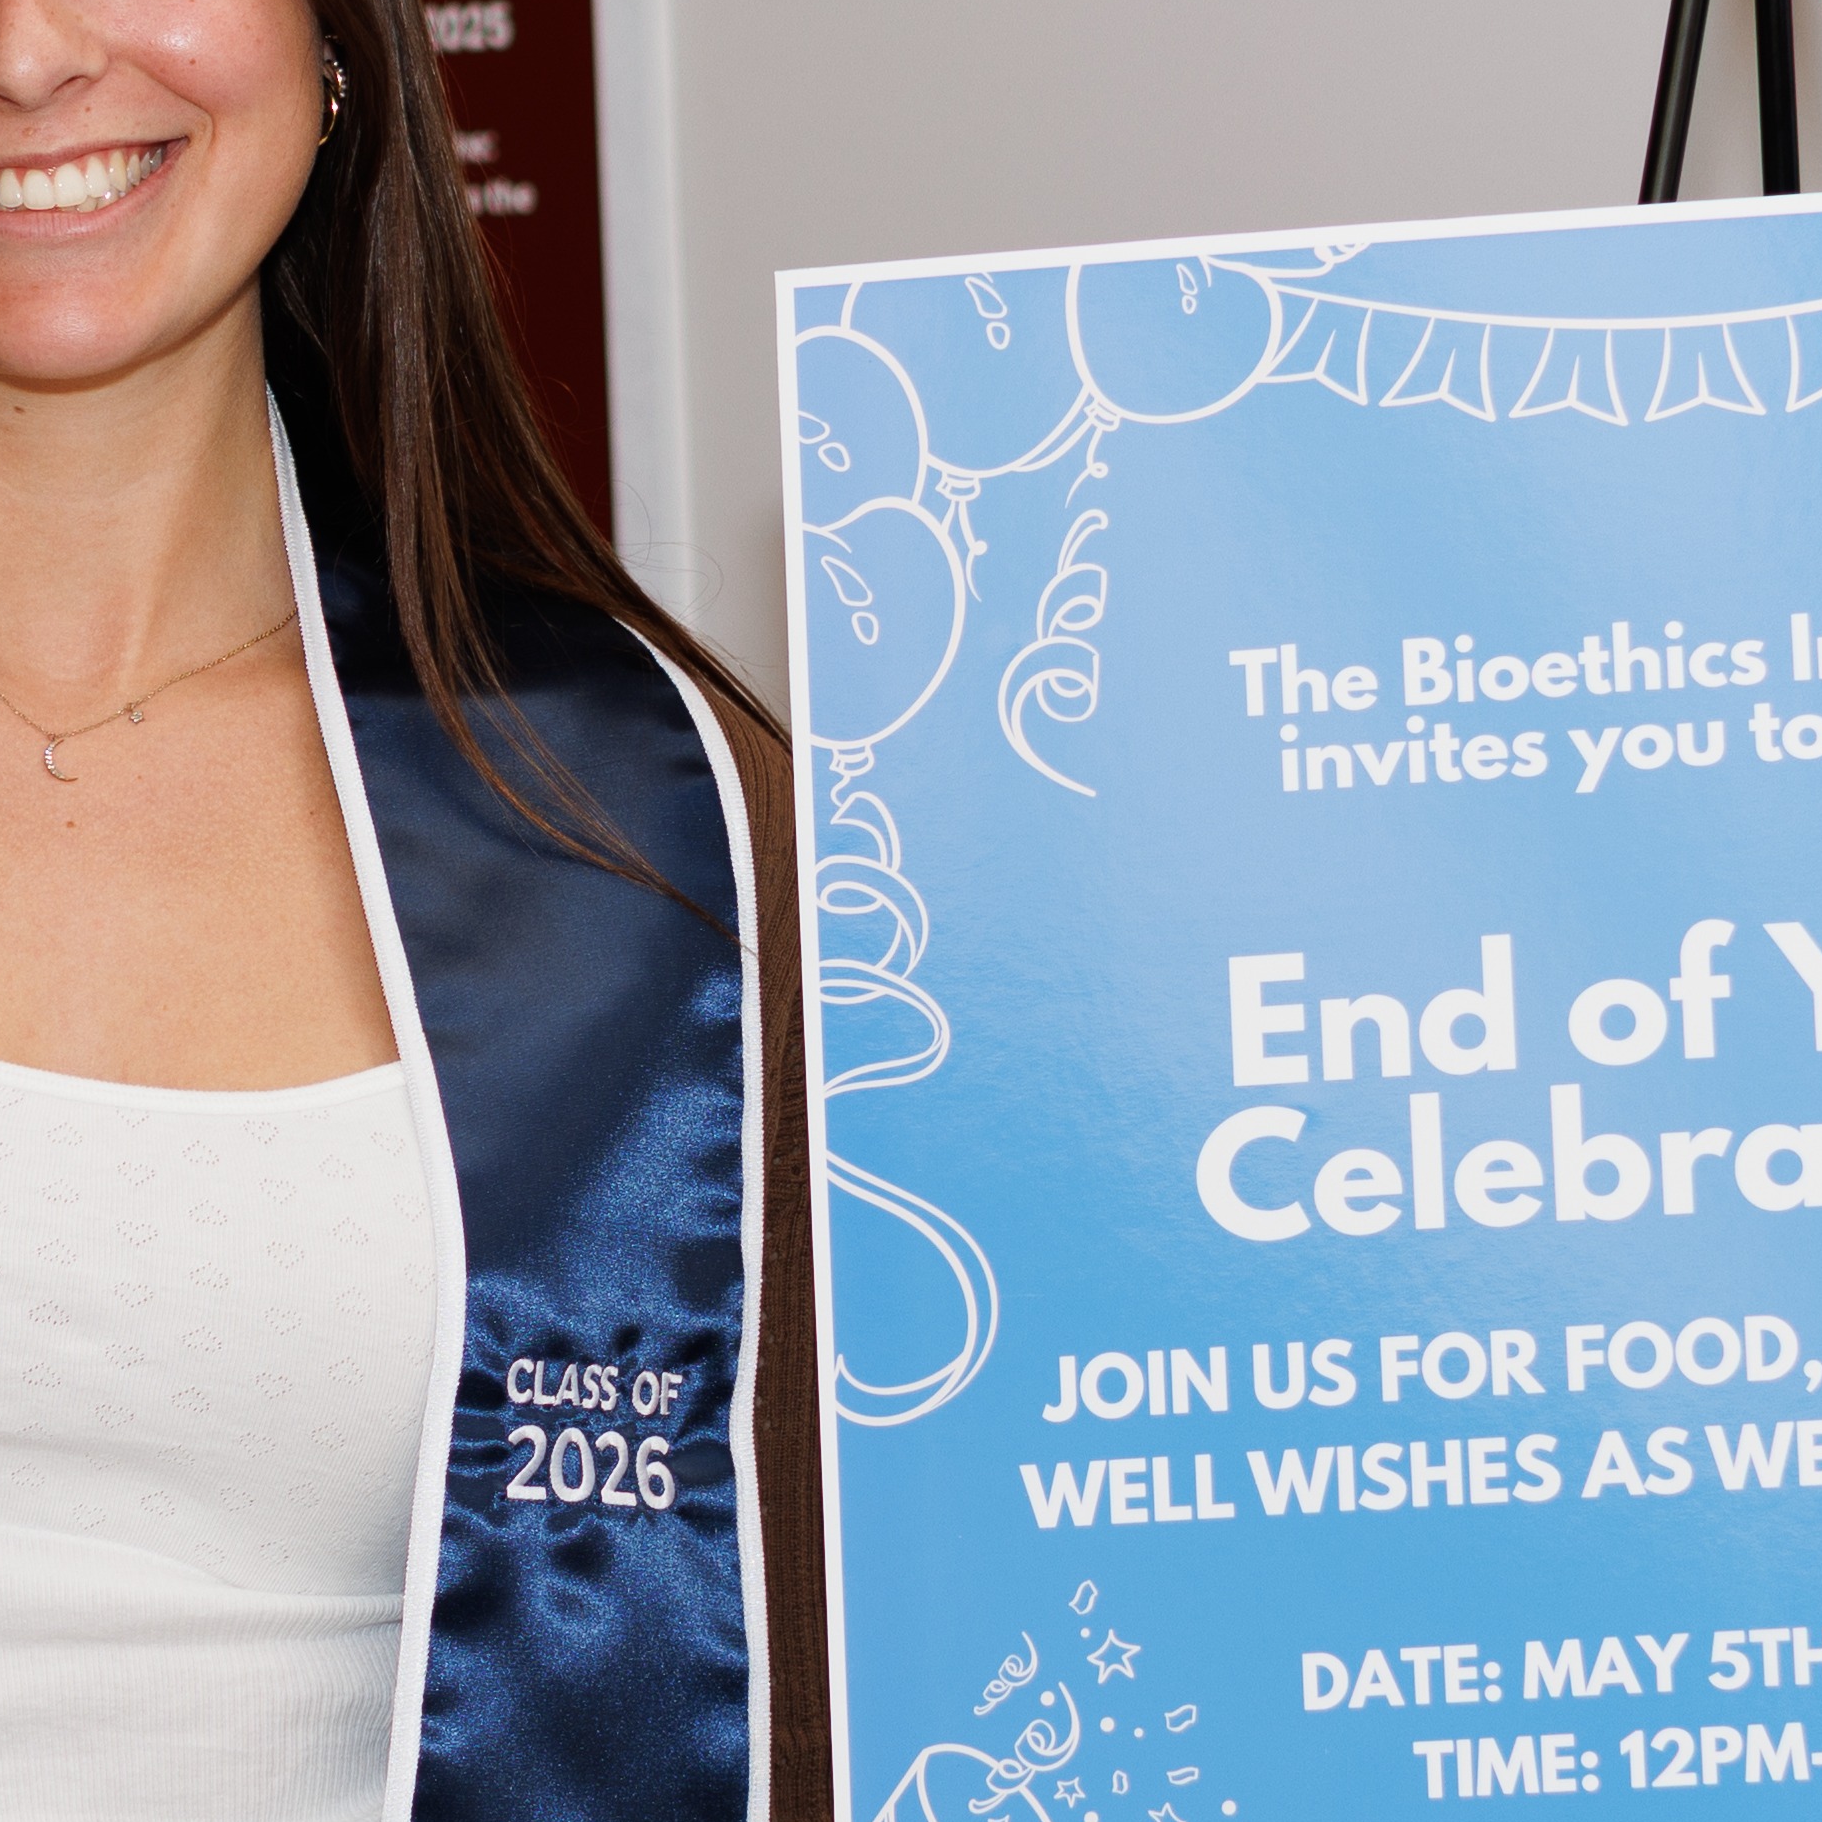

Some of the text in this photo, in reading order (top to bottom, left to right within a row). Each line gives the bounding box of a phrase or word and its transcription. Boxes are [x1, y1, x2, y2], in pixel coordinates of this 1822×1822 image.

[1229, 642, 1379, 718] The
[1401, 619, 1769, 709] Bioethics
[1279, 722, 1550, 794] invites
[1566, 719, 1728, 795] you
[1227, 932, 1519, 1088] End
[1566, 917, 1737, 1068] of
[506, 1357, 684, 1417] CLASS OF
[1041, 1345, 1229, 1424] JOIN
[1251, 1334, 1358, 1411] US
[1379, 1328, 1547, 1403] FOR
[506, 1424, 677, 1511] 2026
[1018, 1453, 1236, 1530] WELL
[1245, 1432, 1563, 1517] WISHES
[1580, 1425, 1695, 1500] AS
[1301, 1643, 1502, 1712] DATE:
[1522, 1635, 1690, 1700] MAY
[1412, 1731, 1601, 1800] TIME:
